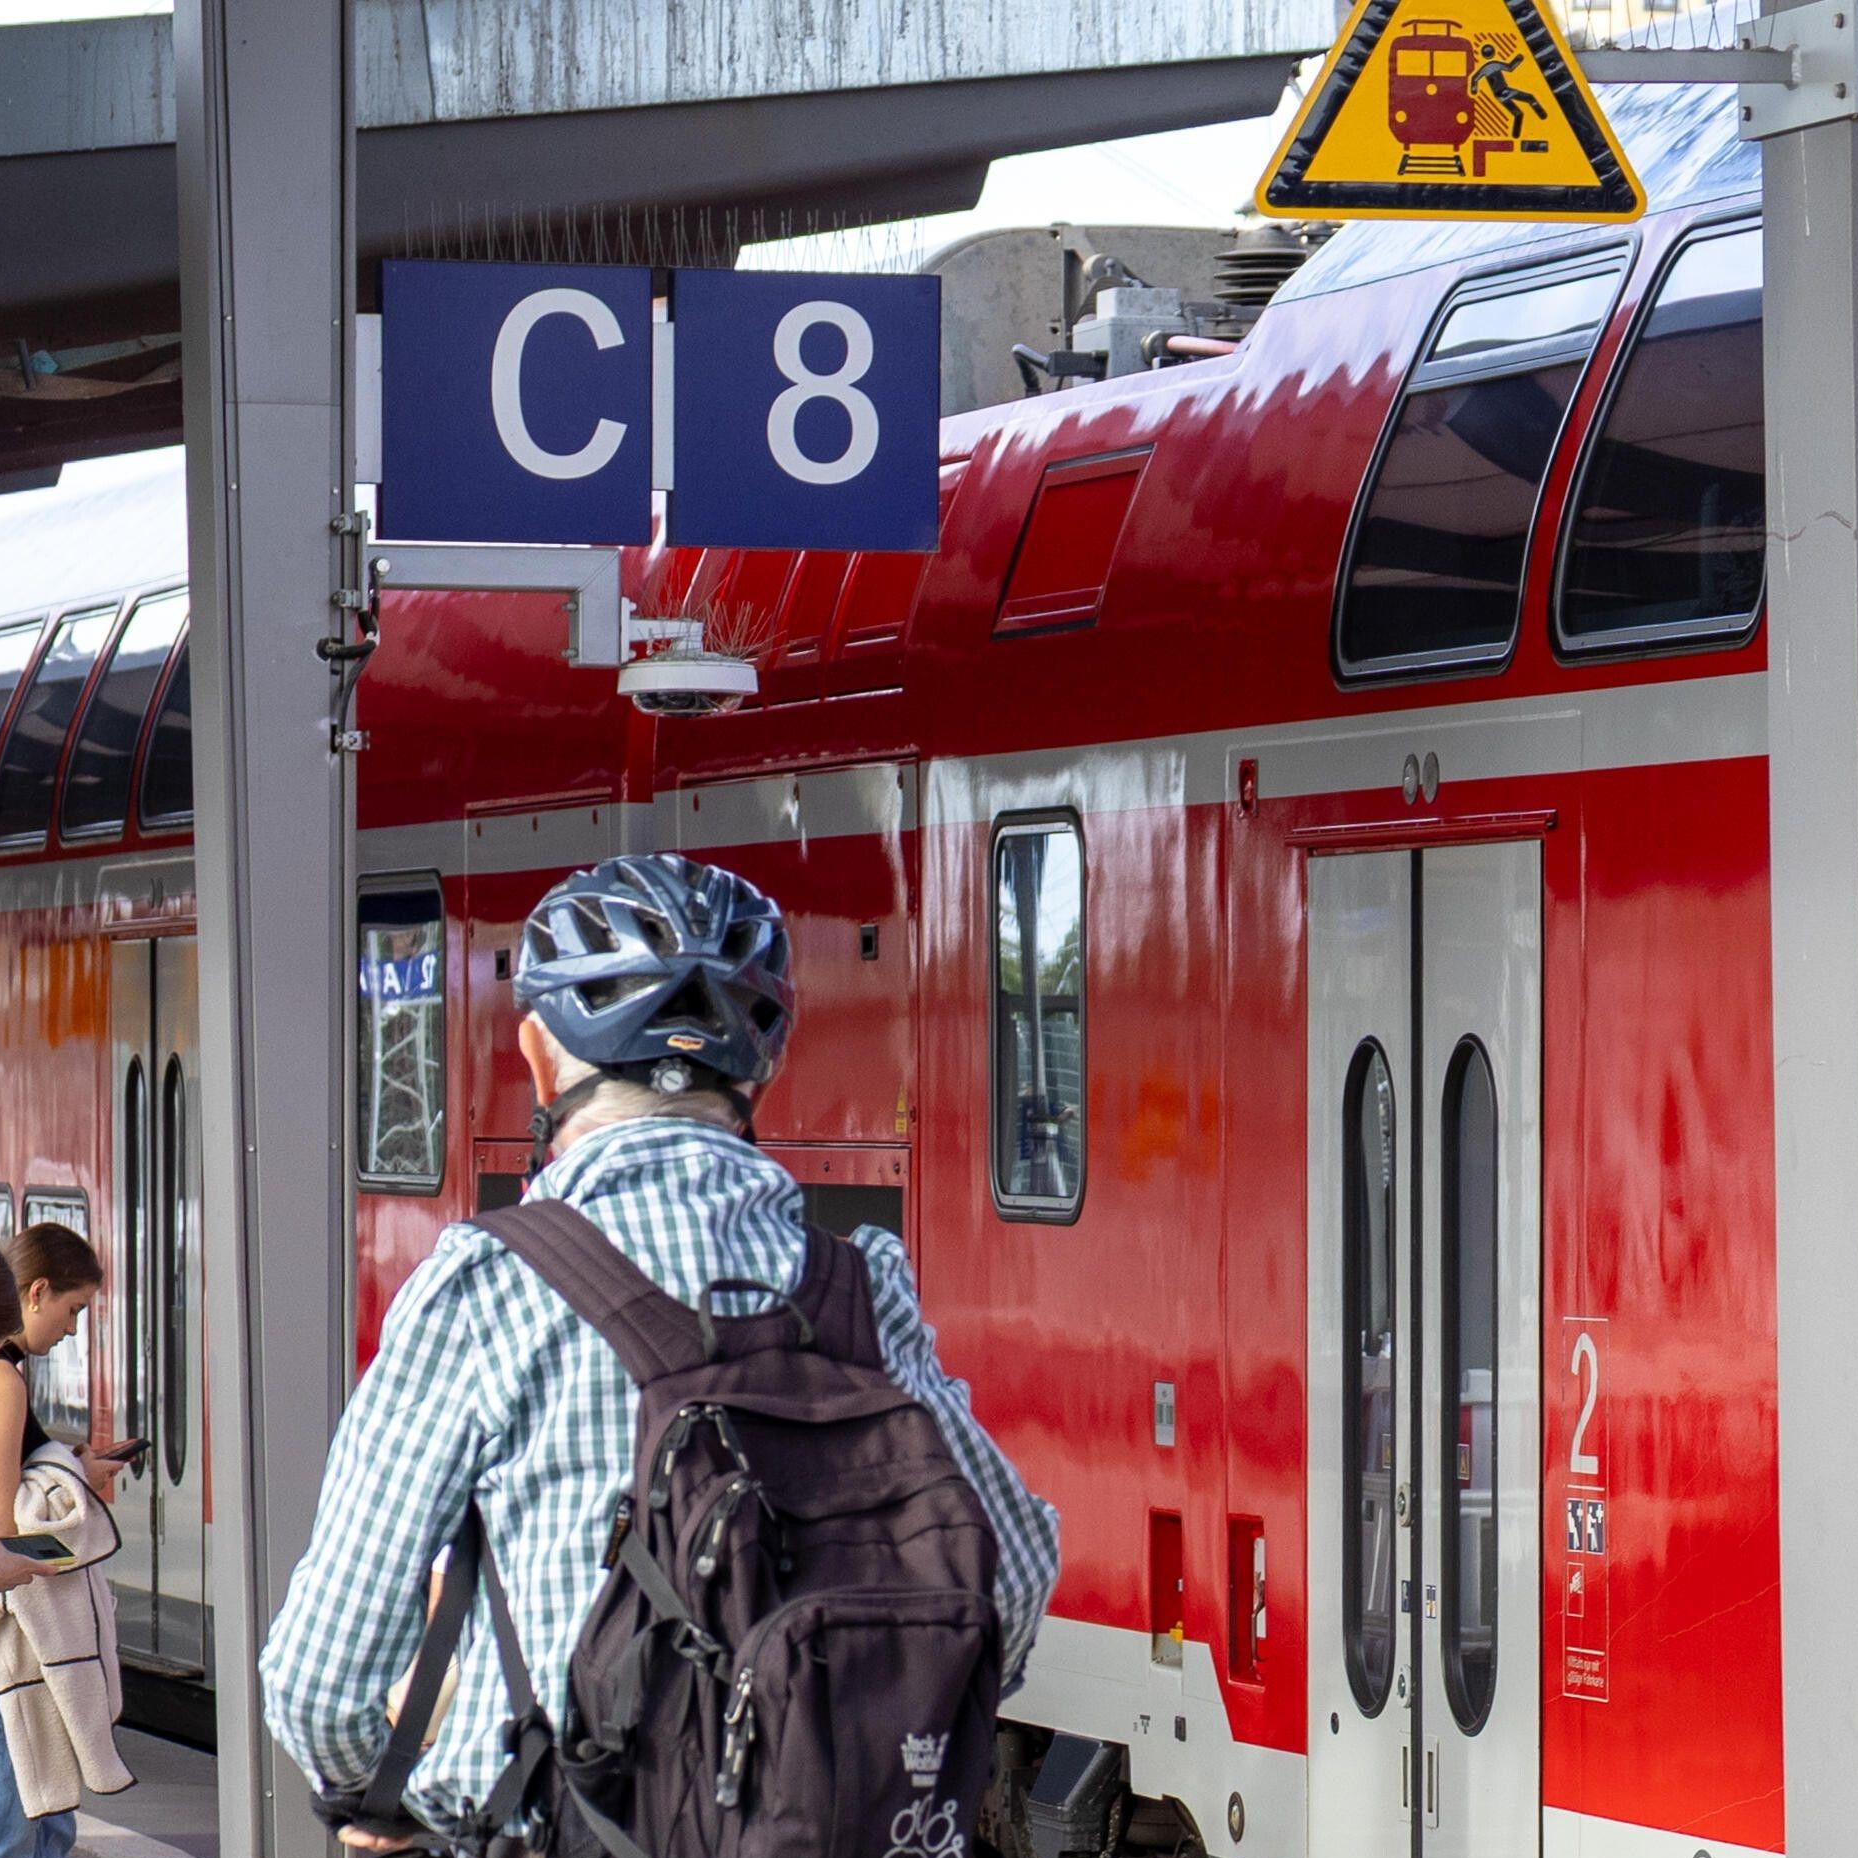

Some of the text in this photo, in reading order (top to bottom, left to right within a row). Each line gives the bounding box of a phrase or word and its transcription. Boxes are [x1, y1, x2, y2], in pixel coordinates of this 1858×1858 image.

[491, 288, 880, 485] C 8
[1568, 1332, 1600, 1475] 2
